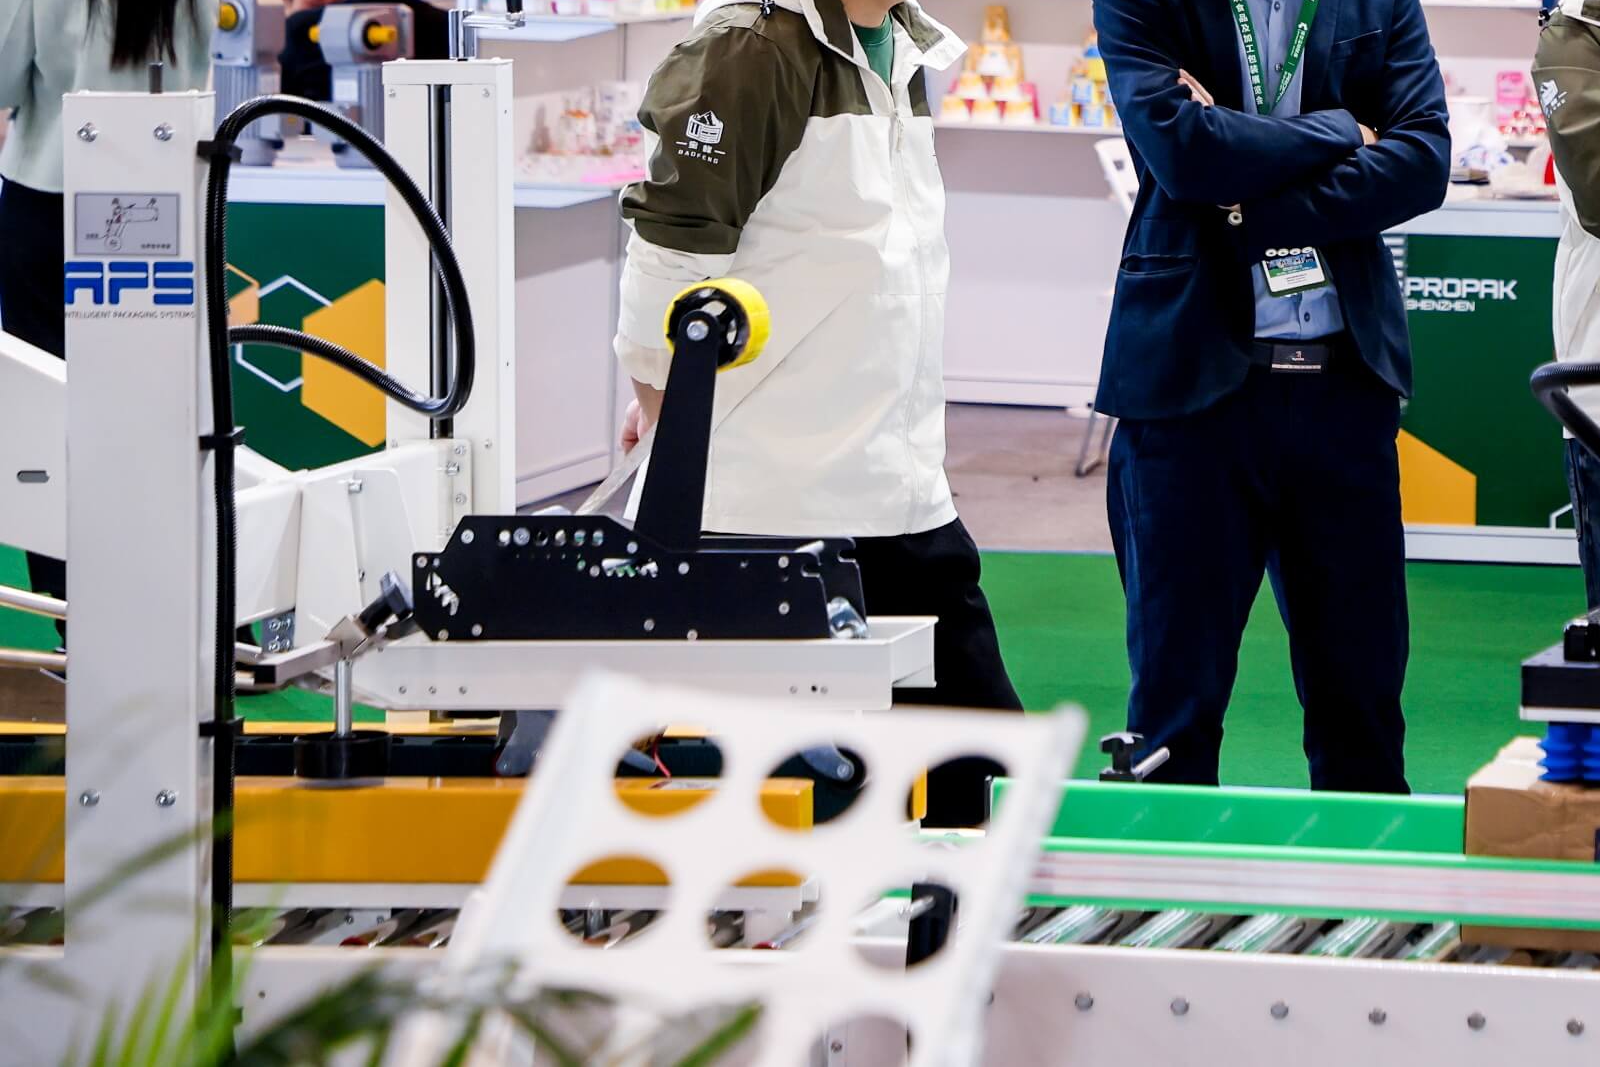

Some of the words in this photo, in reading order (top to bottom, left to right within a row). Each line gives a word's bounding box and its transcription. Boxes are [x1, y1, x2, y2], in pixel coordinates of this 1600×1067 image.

[64, 261, 194, 305] APS
[1404, 276, 1518, 301] PROPAK
[64, 309, 110, 320] NTELLIGENT
[1405, 299, 1476, 312] SHENZHEN
